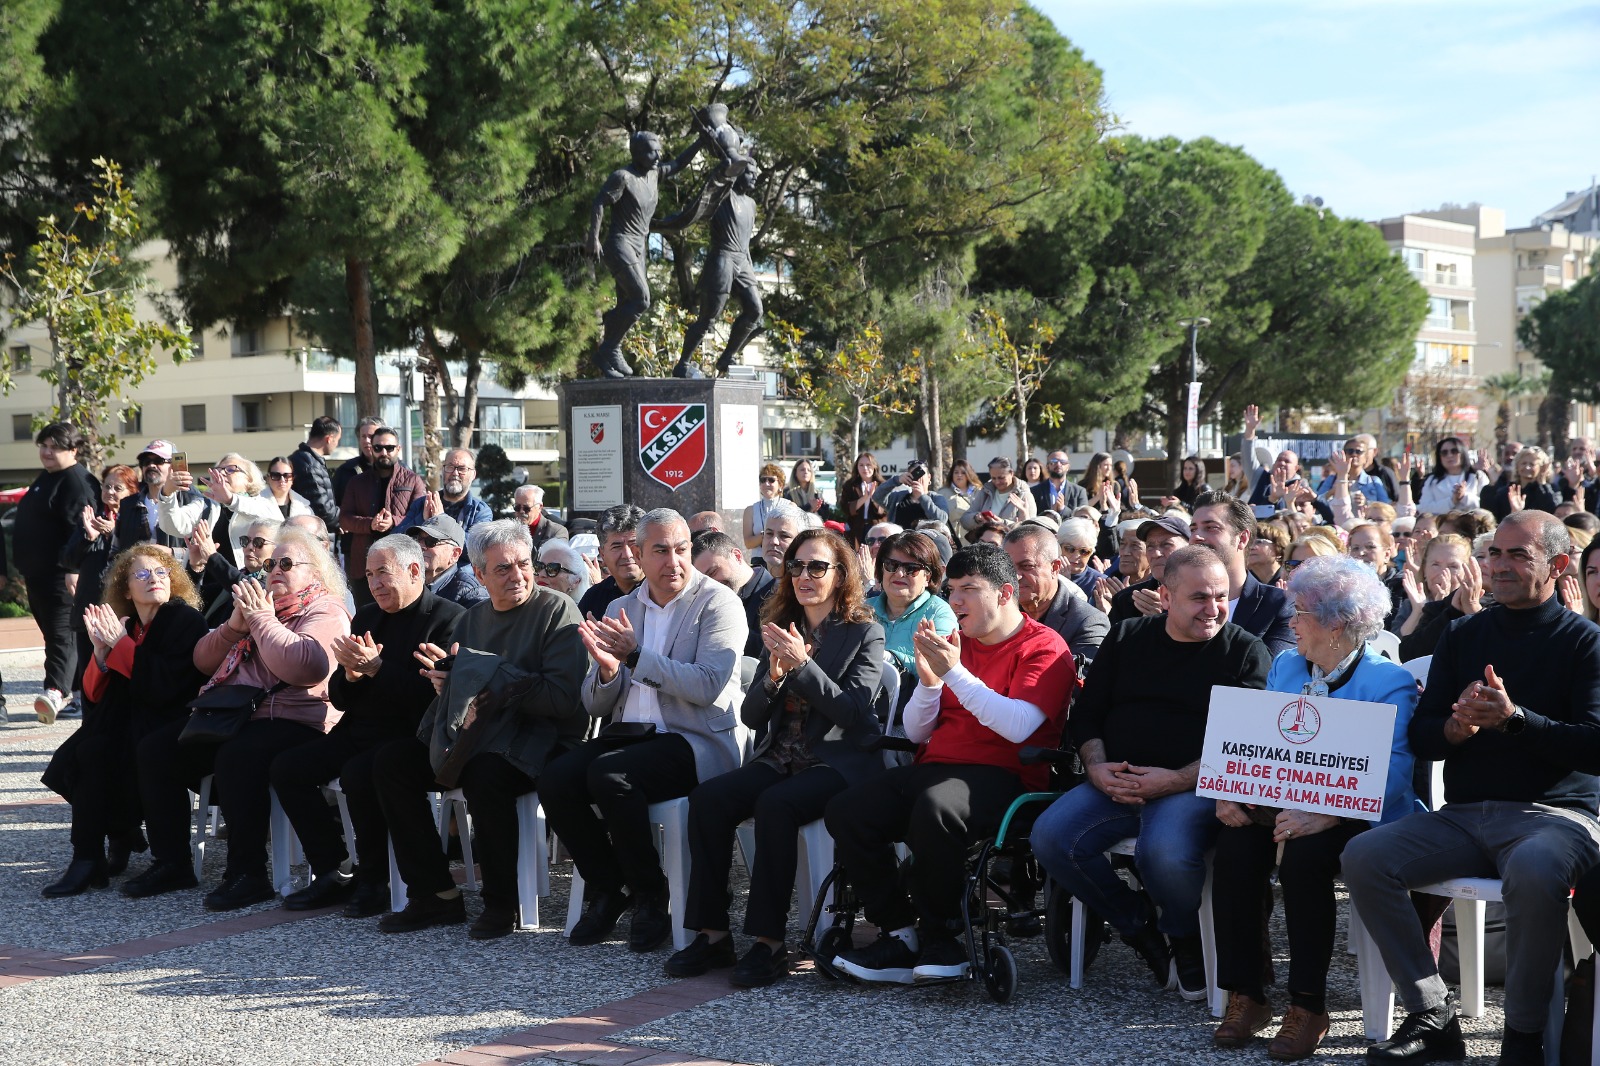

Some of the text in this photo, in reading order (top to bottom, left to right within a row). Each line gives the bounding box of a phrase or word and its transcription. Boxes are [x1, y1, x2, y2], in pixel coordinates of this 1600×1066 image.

[646, 415, 698, 462] K.S.K.
[665, 470, 683, 478] 1912
[1221, 741, 1369, 772] KARŞIYAKA BELEDİYESİ
[1226, 759, 1358, 790] BİLGE ÇINARLAR
[1199, 775, 1382, 813] SAĞLIKLI YAŞ ALMA MERKEZİ
